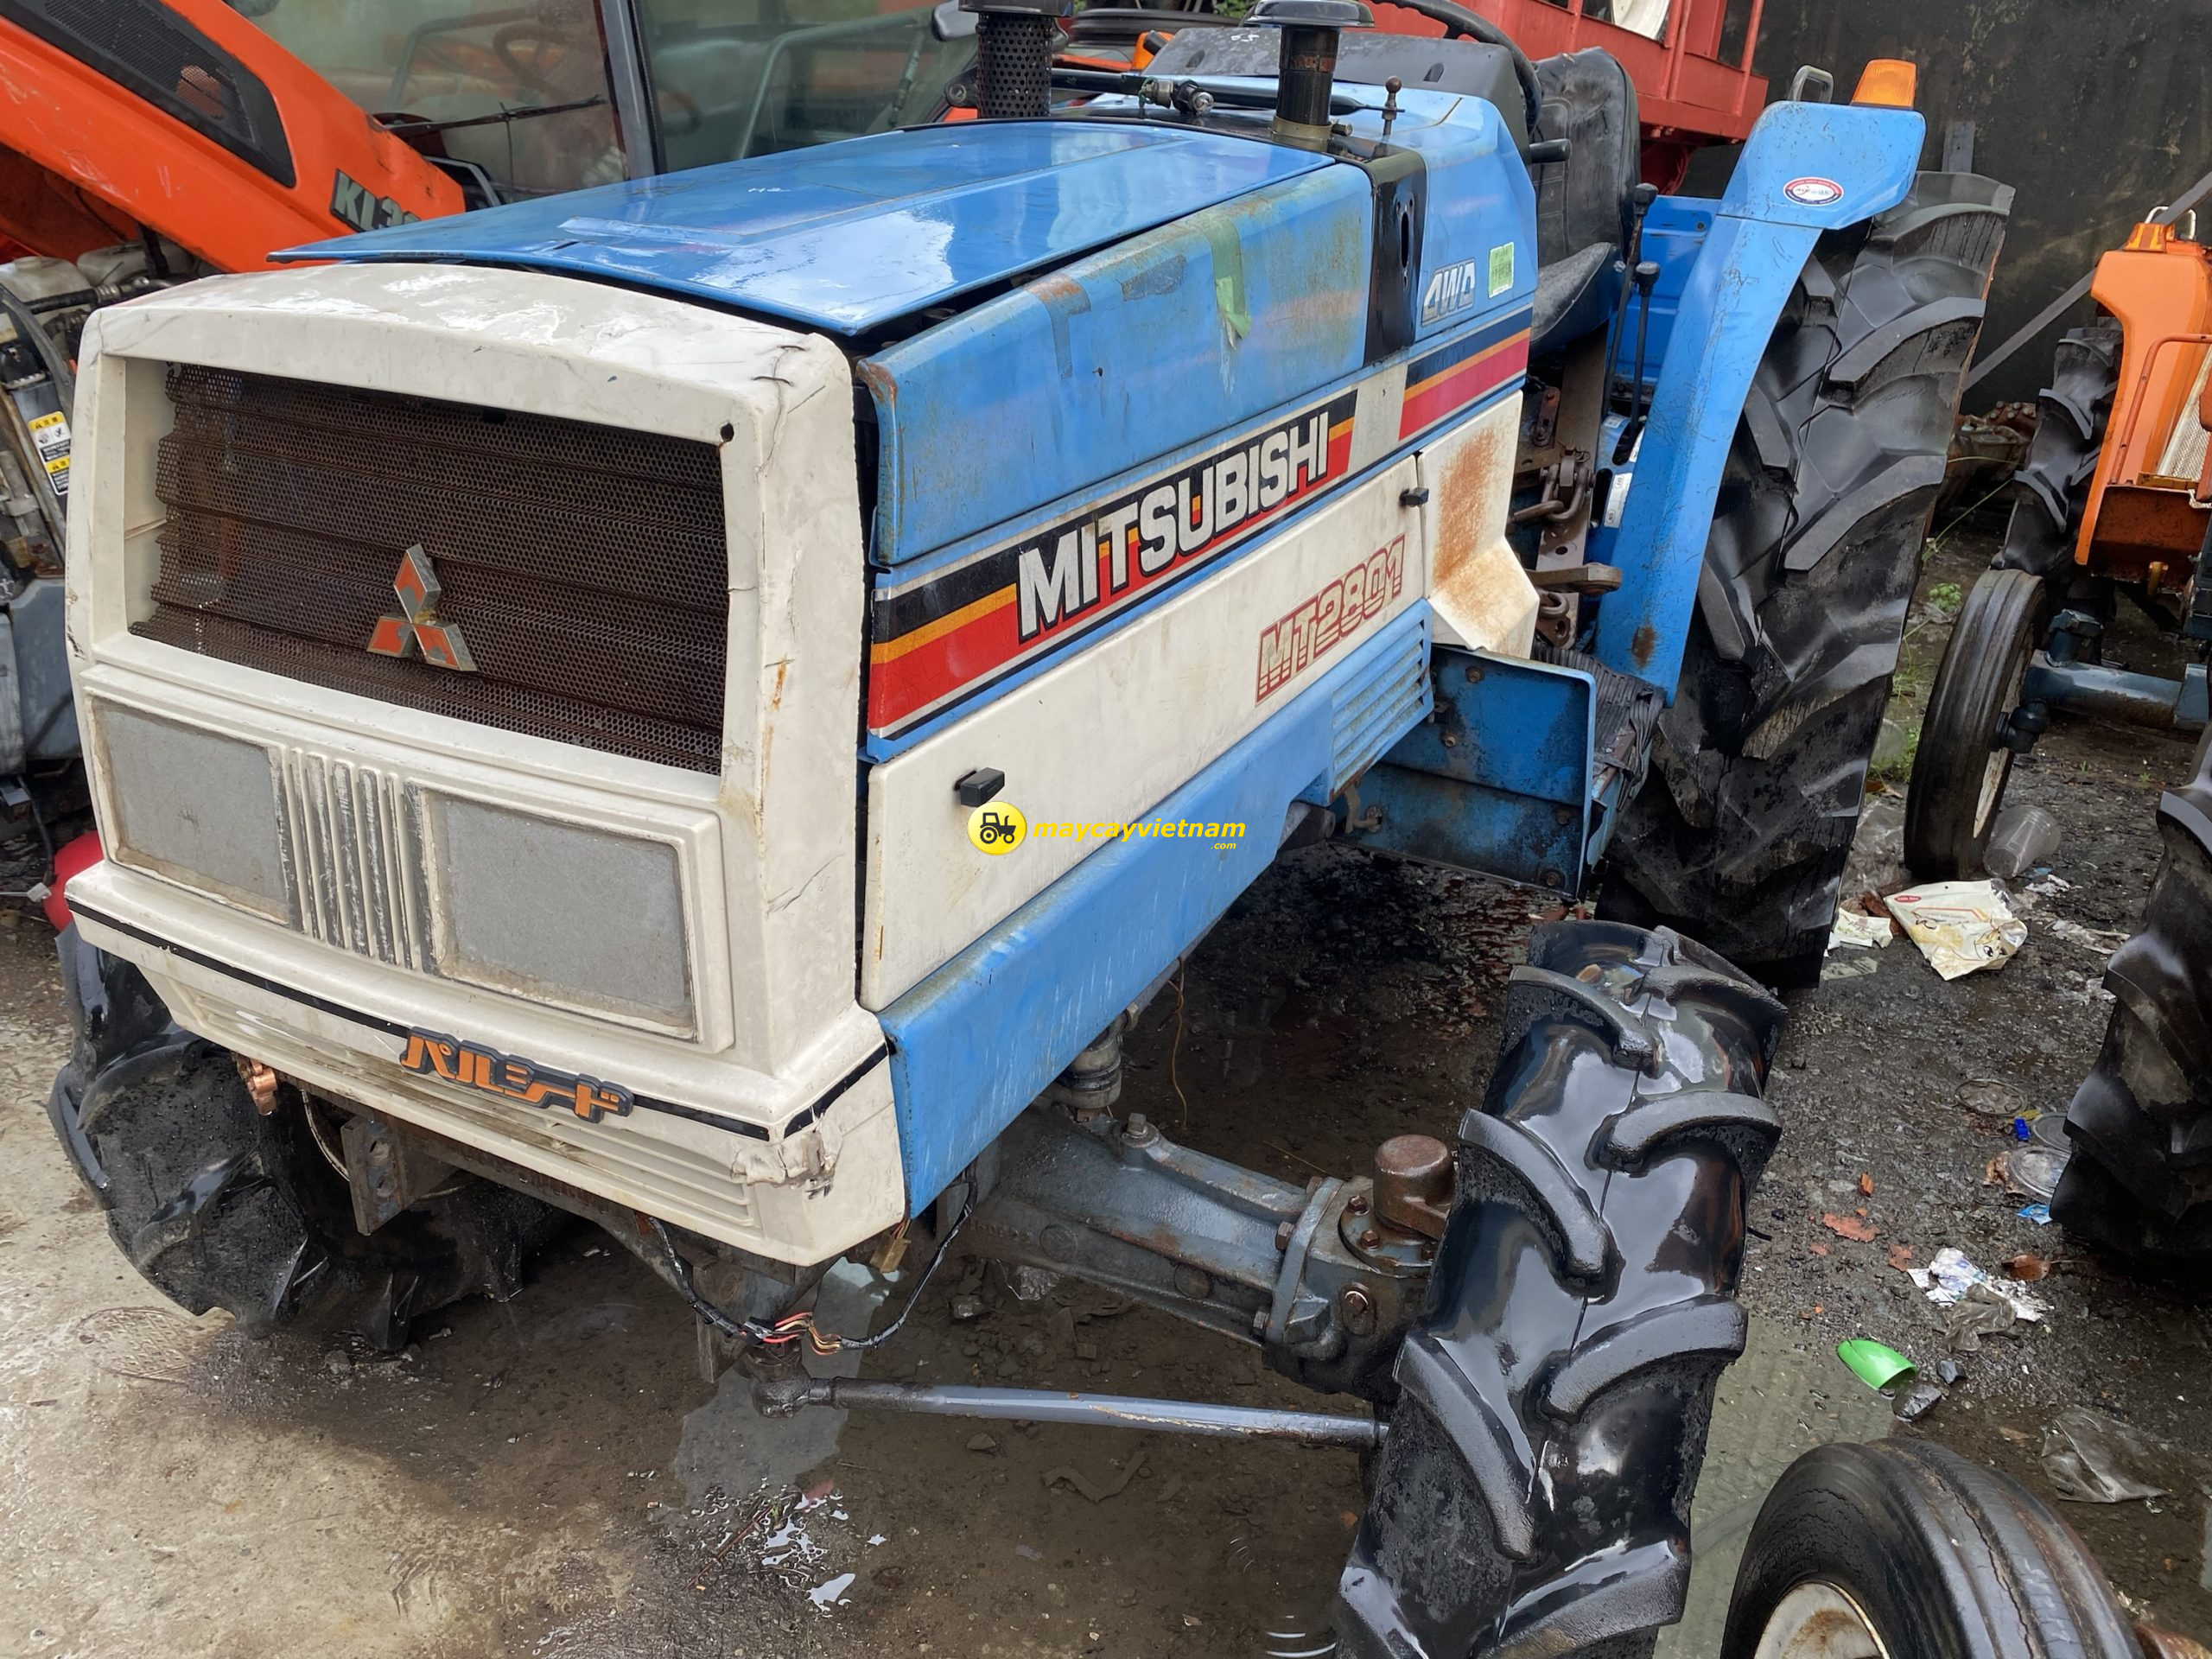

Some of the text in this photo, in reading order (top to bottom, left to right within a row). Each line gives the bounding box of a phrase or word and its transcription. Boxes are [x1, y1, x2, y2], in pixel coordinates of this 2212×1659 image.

[1421, 258, 1475, 325] 4WD
[1018, 411, 1329, 638] MITSUBISHI
[1256, 532, 1405, 704] MT2801
